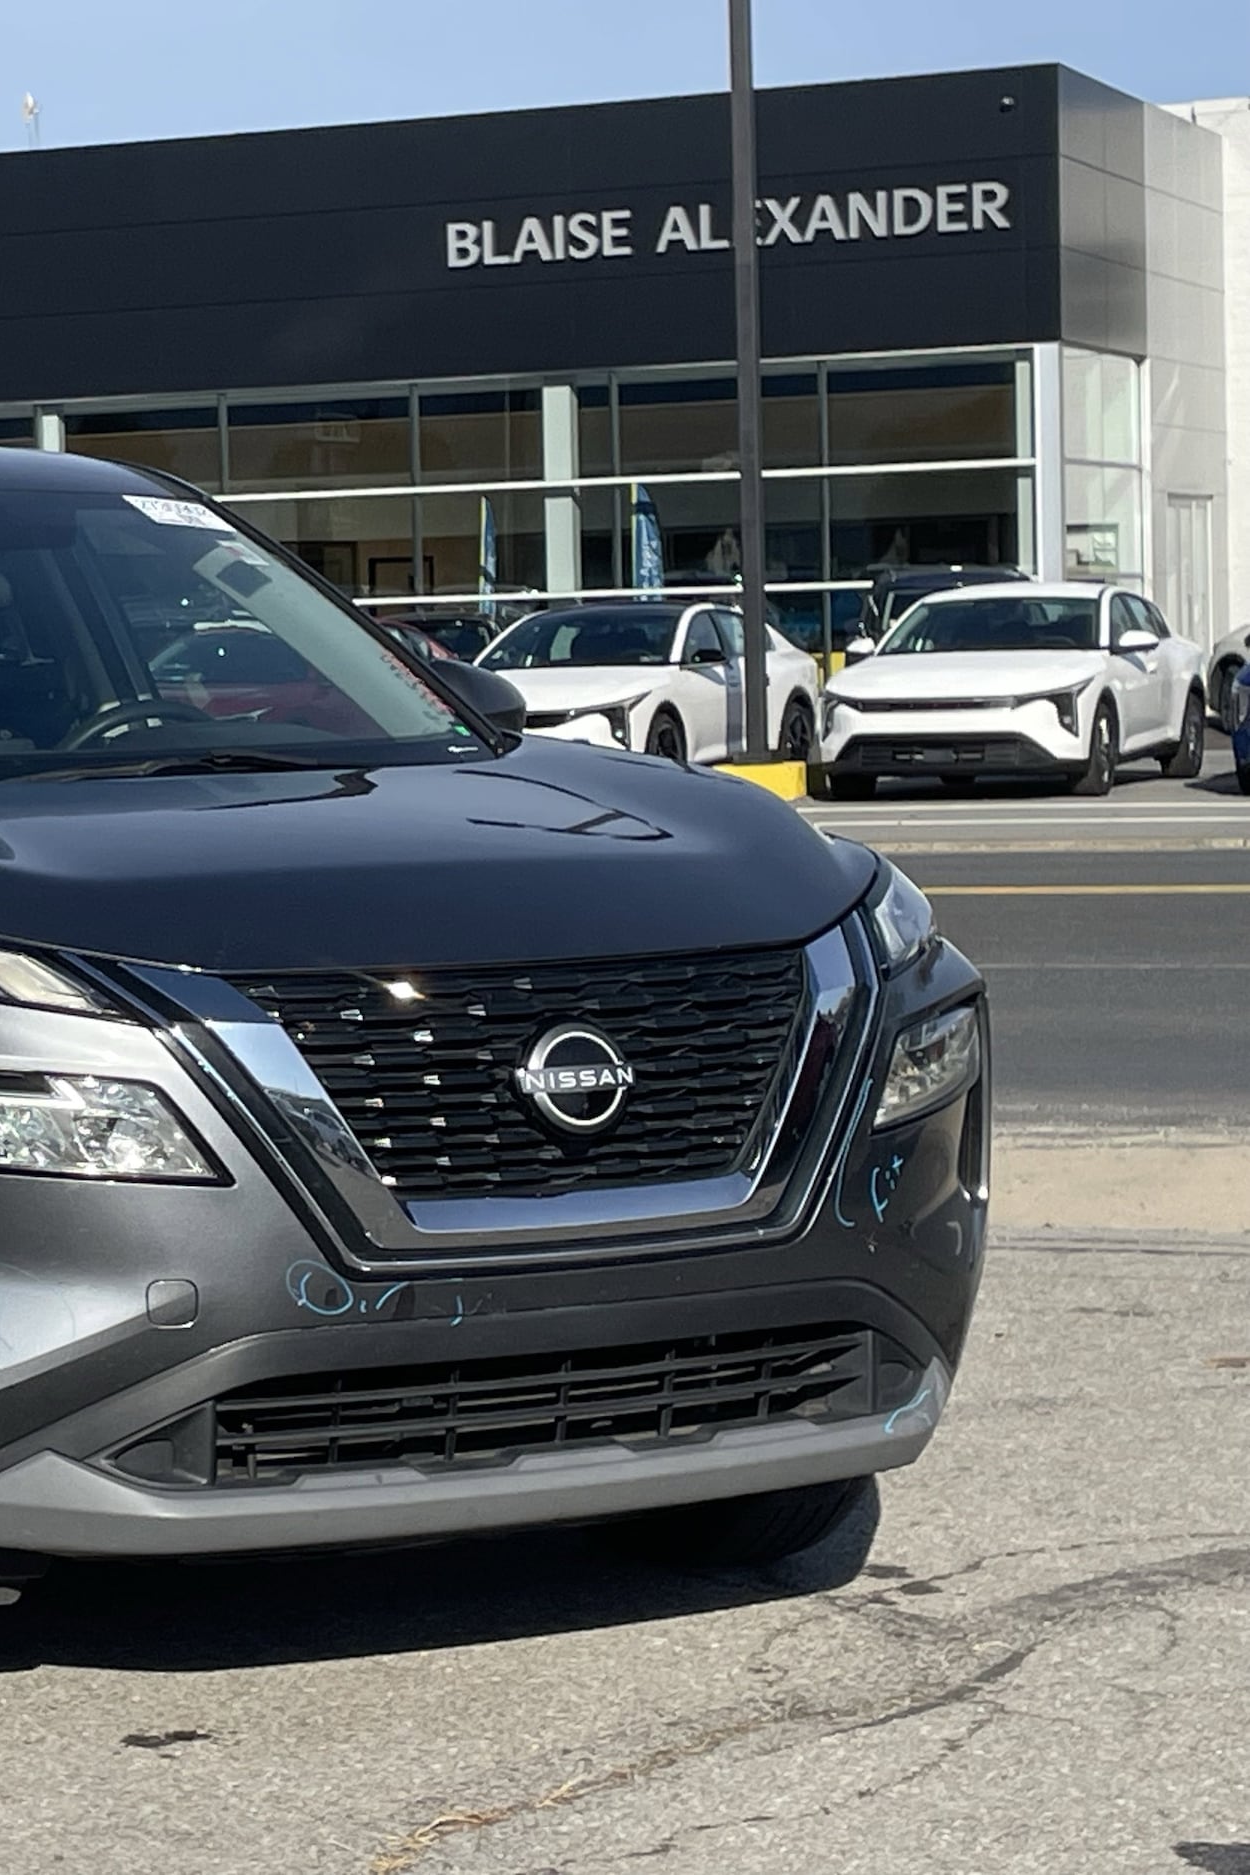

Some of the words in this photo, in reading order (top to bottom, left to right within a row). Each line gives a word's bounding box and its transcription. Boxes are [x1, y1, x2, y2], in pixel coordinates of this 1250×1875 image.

[446, 209, 633, 268] BLAISE
[655, 181, 1011, 253] ALXANDER
[525, 1066, 634, 1090] NISSAN
